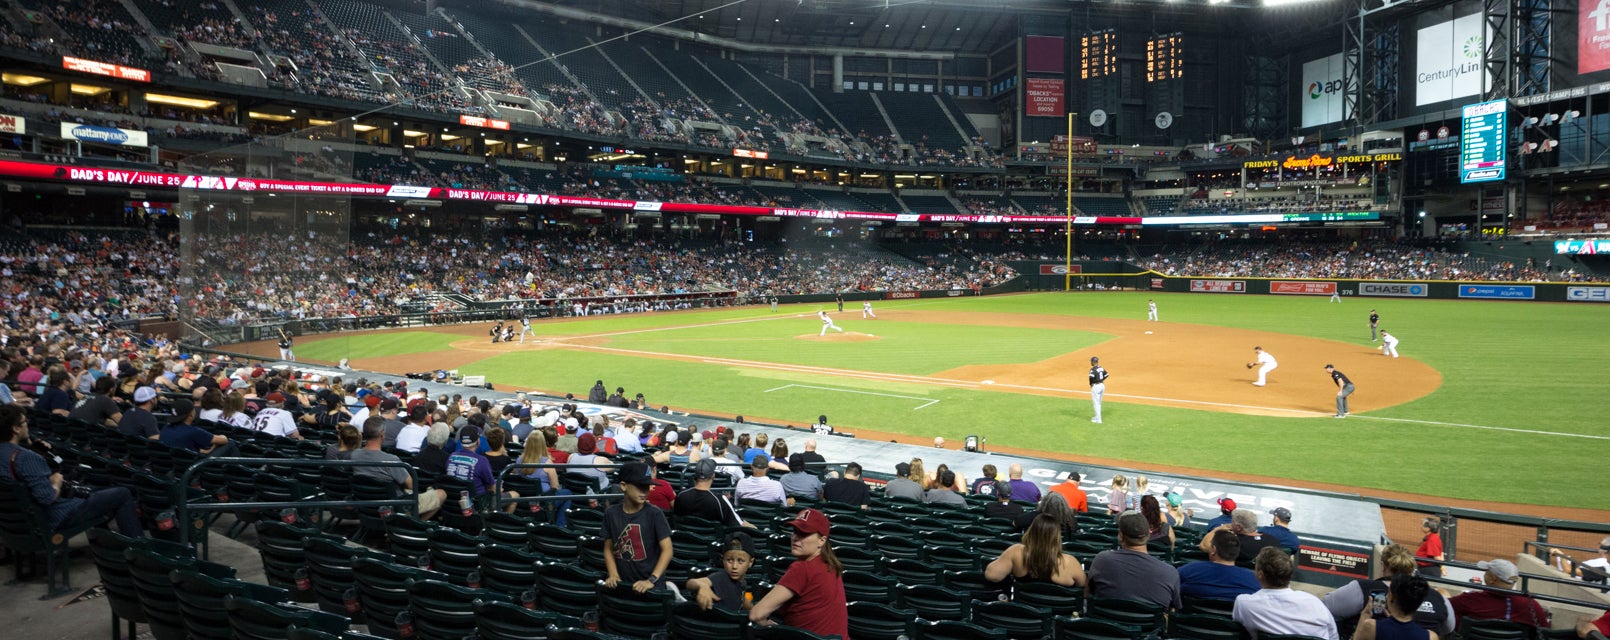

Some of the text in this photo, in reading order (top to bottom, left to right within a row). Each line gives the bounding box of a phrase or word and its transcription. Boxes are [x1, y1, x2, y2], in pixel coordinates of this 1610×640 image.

[1417, 61, 1483, 84] CenturyLin
[1323, 77, 1348, 96] ap
[1546, 88, 1585, 101] CHAMPIONS
[1244, 160, 1279, 168] FRIDAY'S
[1337, 154, 1372, 163] SPORTS
[1374, 153, 1402, 162] GRILL
[71, 168, 104, 181] DAD'S
[167, 176, 181, 186] 25
[449, 189, 469, 199] DAD'S
[1365, 285, 1408, 294] CHASE
[1310, 555, 1331, 563] LEAVING
[1346, 555, 1368, 563] OBJECTS
